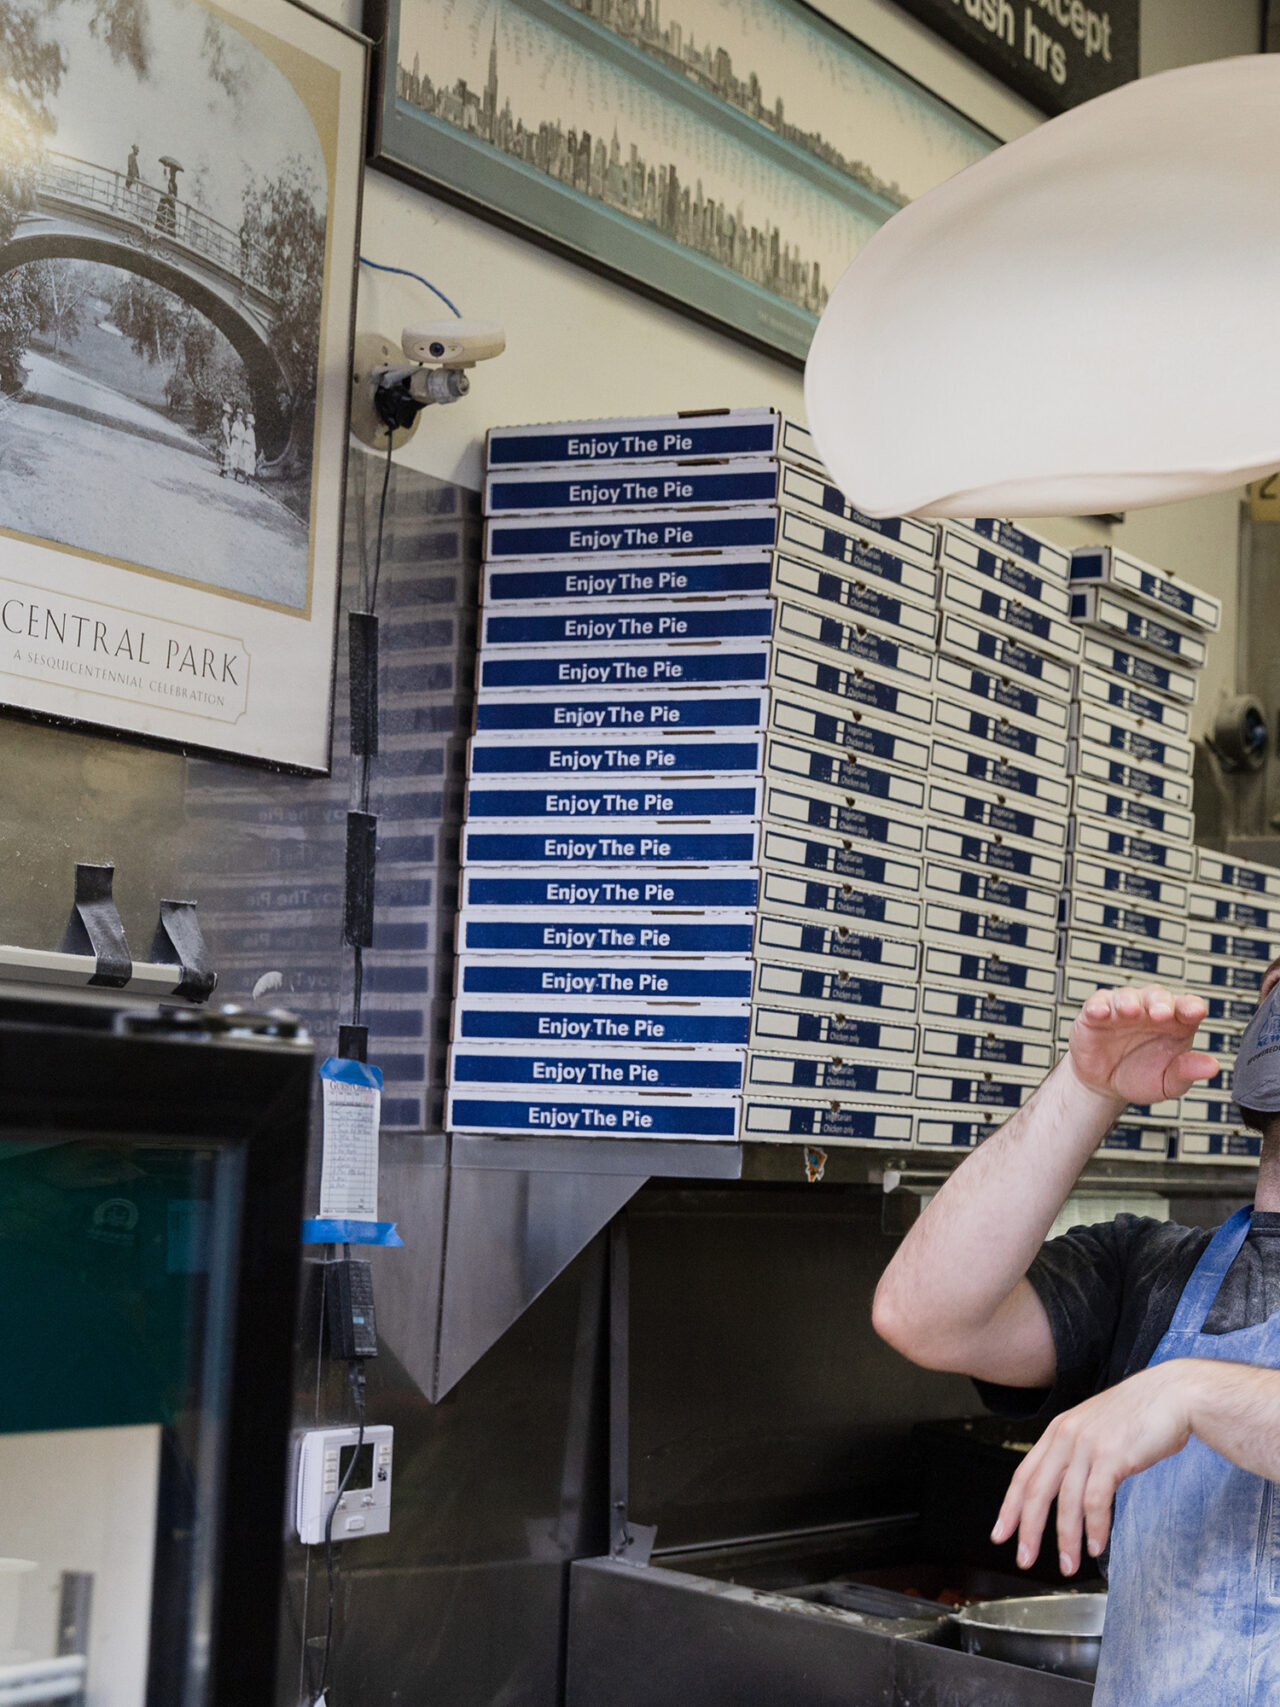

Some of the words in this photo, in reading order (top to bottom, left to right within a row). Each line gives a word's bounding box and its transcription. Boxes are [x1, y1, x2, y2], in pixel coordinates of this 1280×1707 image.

[1030, 0, 1111, 62] cept
[953, 0, 1015, 47] ush
[1024, 6, 1068, 85] hrs
[568, 439, 619, 458] Enjoy
[622, 436, 658, 453] The
[664, 434, 693, 451] Pie
[569, 485, 620, 505] Enjoy
[623, 483, 658, 499] The
[664, 480, 693, 497] Pie
[570, 531, 621, 551] Enjoy
[624, 529, 659, 545] The
[664, 526, 693, 543] Pie
[566, 576, 616, 595] Enjoy
[619, 574, 653, 590] The
[659, 572, 688, 589] Pie
[565, 621, 616, 640] Enjoy
[619, 619, 653, 635] The
[659, 617, 688, 634] Pie
[2, 599, 151, 665] CENTRAL
[166, 639, 239, 686] PARK
[13, 649, 22, 661] A
[28, 652, 144, 689] SESQUICENTENNIAL
[149, 680, 225, 706] CELEBRATION
[558, 664, 610, 683] Enjoy
[613, 662, 648, 679] The
[653, 661, 683, 678] Pie
[554, 707, 605, 727] Enjoy
[608, 706, 645, 723] The
[650, 705, 680, 722] Pie
[550, 751, 601, 770] Enjoy
[605, 750, 640, 767] The
[646, 750, 675, 766] Pie
[546, 795, 600, 816] Enjoy
[603, 794, 639, 811] The
[645, 794, 673, 810] Pie
[545, 839, 597, 859] Enjoy
[599, 839, 635, 856] The
[640, 840, 671, 856] Pie
[547, 884, 599, 904] Enjoy
[603, 884, 639, 900] The
[645, 885, 675, 901] Pie
[543, 928, 596, 949] Enjoy
[599, 929, 635, 946] The
[640, 930, 670, 946] Pie
[542, 973, 595, 994] Enjoy
[598, 973, 634, 991] The
[639, 974, 669, 992] Pie
[538, 1018, 591, 1039] Enjoy
[594, 1019, 629, 1036] The
[634, 1020, 664, 1037] Pie
[533, 1063, 585, 1083] Enjoy
[588, 1063, 623, 1081] The
[629, 1065, 659, 1082] Pie
[528, 1107, 581, 1128] Enjoy
[582, 1109, 618, 1126] The
[622, 1110, 653, 1127] Pie
